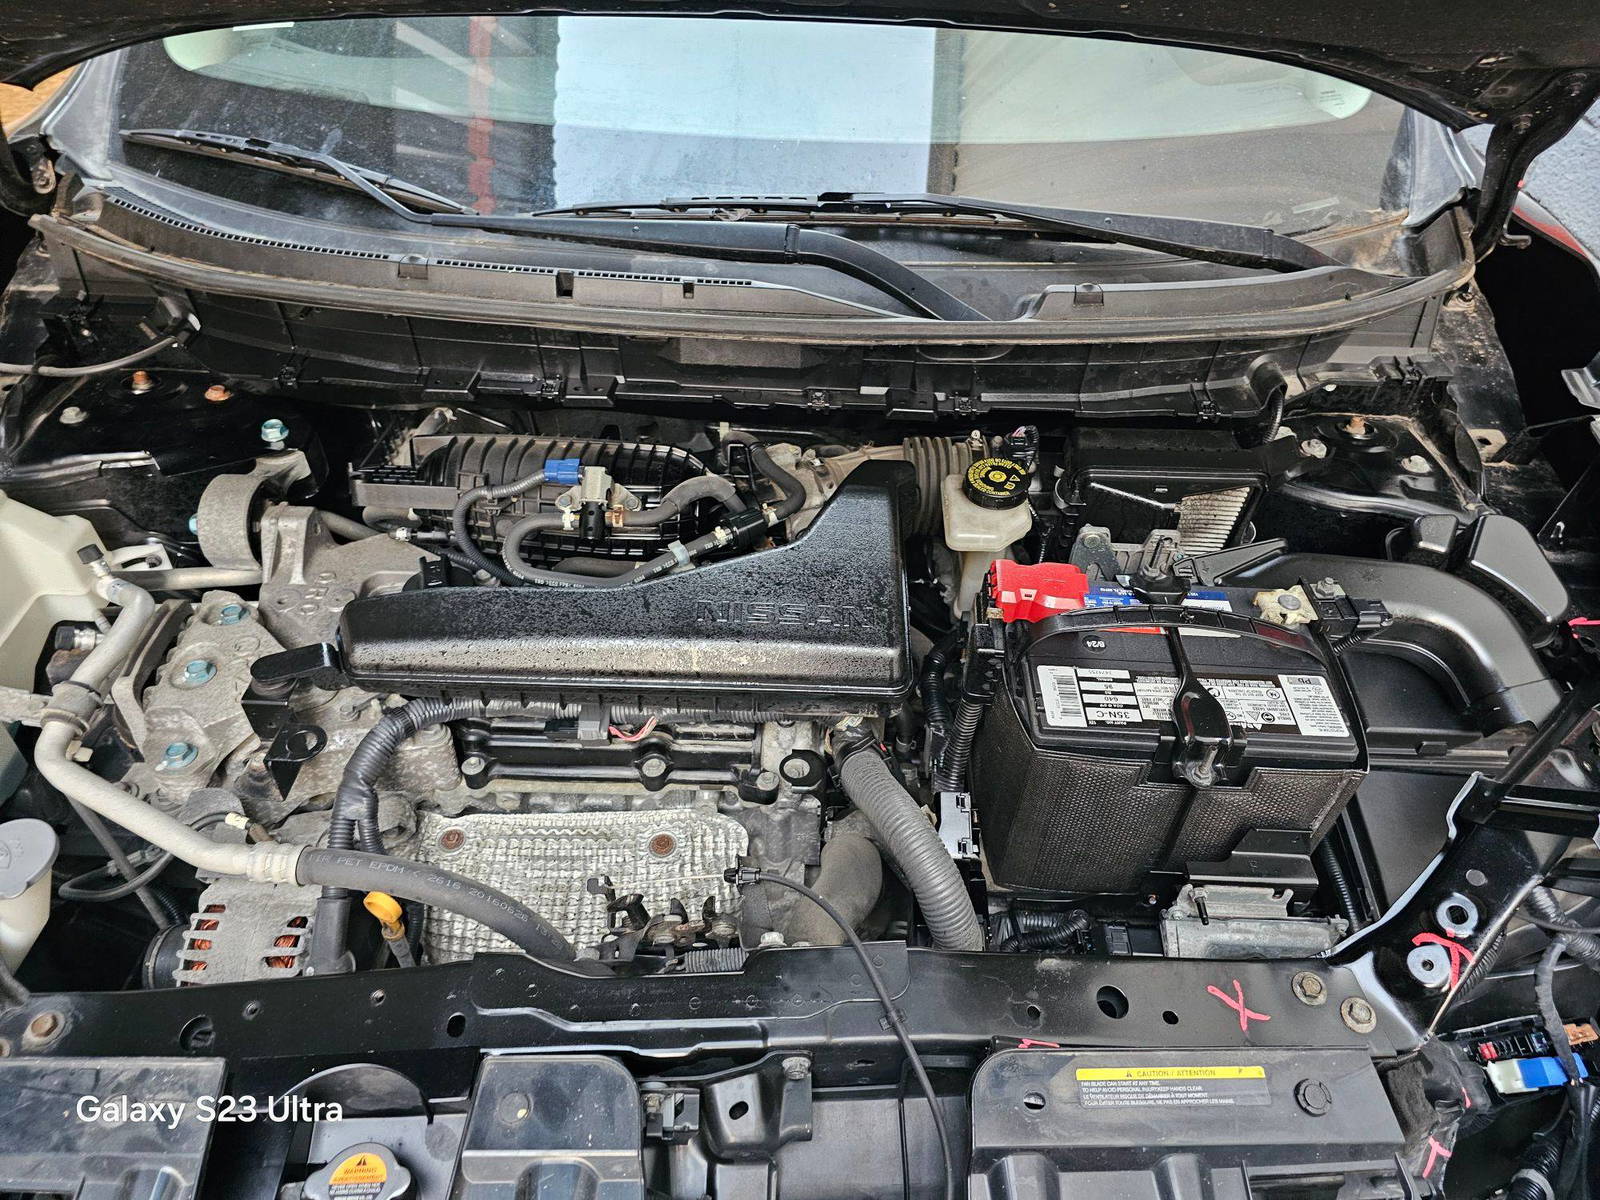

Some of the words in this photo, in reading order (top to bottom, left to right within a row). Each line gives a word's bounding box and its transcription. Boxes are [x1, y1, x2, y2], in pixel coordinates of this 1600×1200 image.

[698, 600, 874, 628] NISSAN
[1298, 677, 1312, 685] Pb
[1096, 710, 1130, 719] 35N-C
[368, 860, 405, 874] EPDM
[1136, 1070, 1169, 1078] CAUTION
